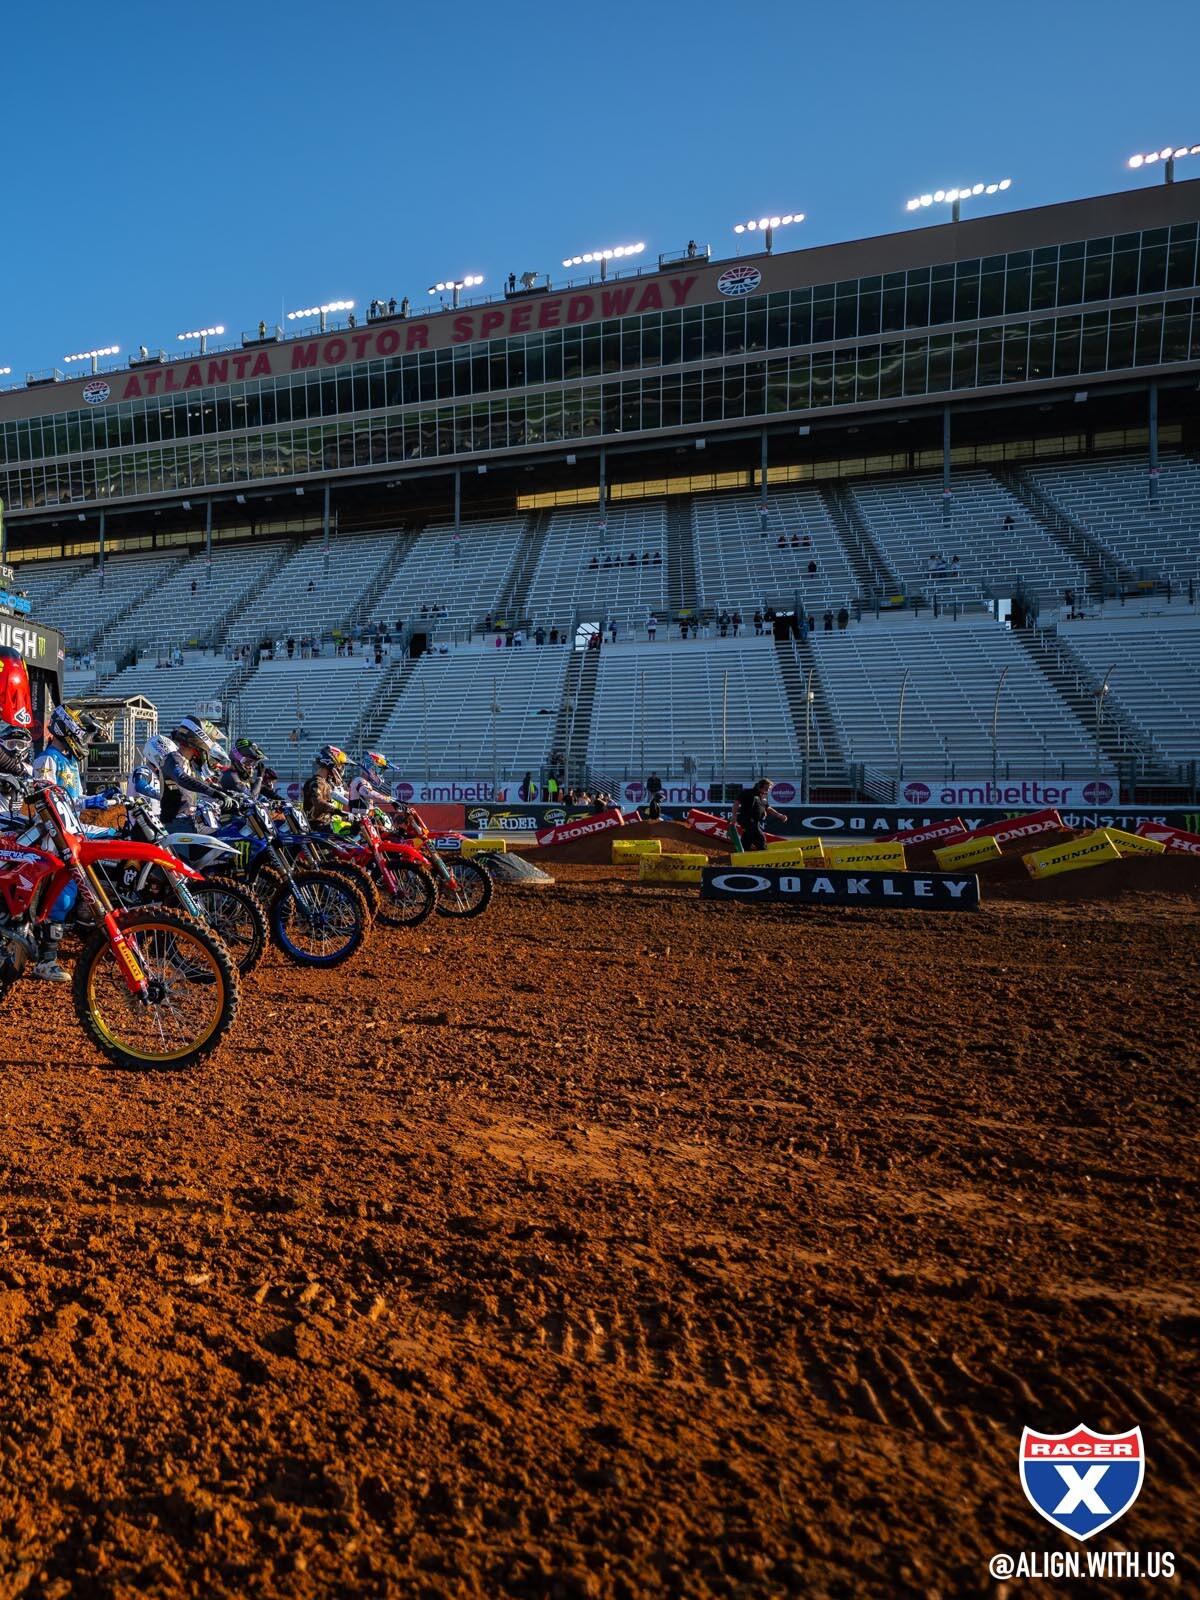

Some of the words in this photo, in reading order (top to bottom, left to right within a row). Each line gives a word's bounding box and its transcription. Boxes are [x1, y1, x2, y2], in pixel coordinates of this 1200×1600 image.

[122, 351, 272, 399] ATLANTA
[291, 323, 431, 370] MOTOR
[452, 275, 698, 343] SPEEDWAY
[940, 782, 1073, 805] ambetter
[557, 817, 619, 841] HONDA
[900, 823, 963, 845] HONDA
[995, 818, 1061, 843] ONDA
[847, 853, 901, 863] DUNLOP
[953, 844, 998, 862] DUNLOP
[1051, 841, 1110, 865] DUNLOP
[779, 876, 969, 897] OAKLEY
